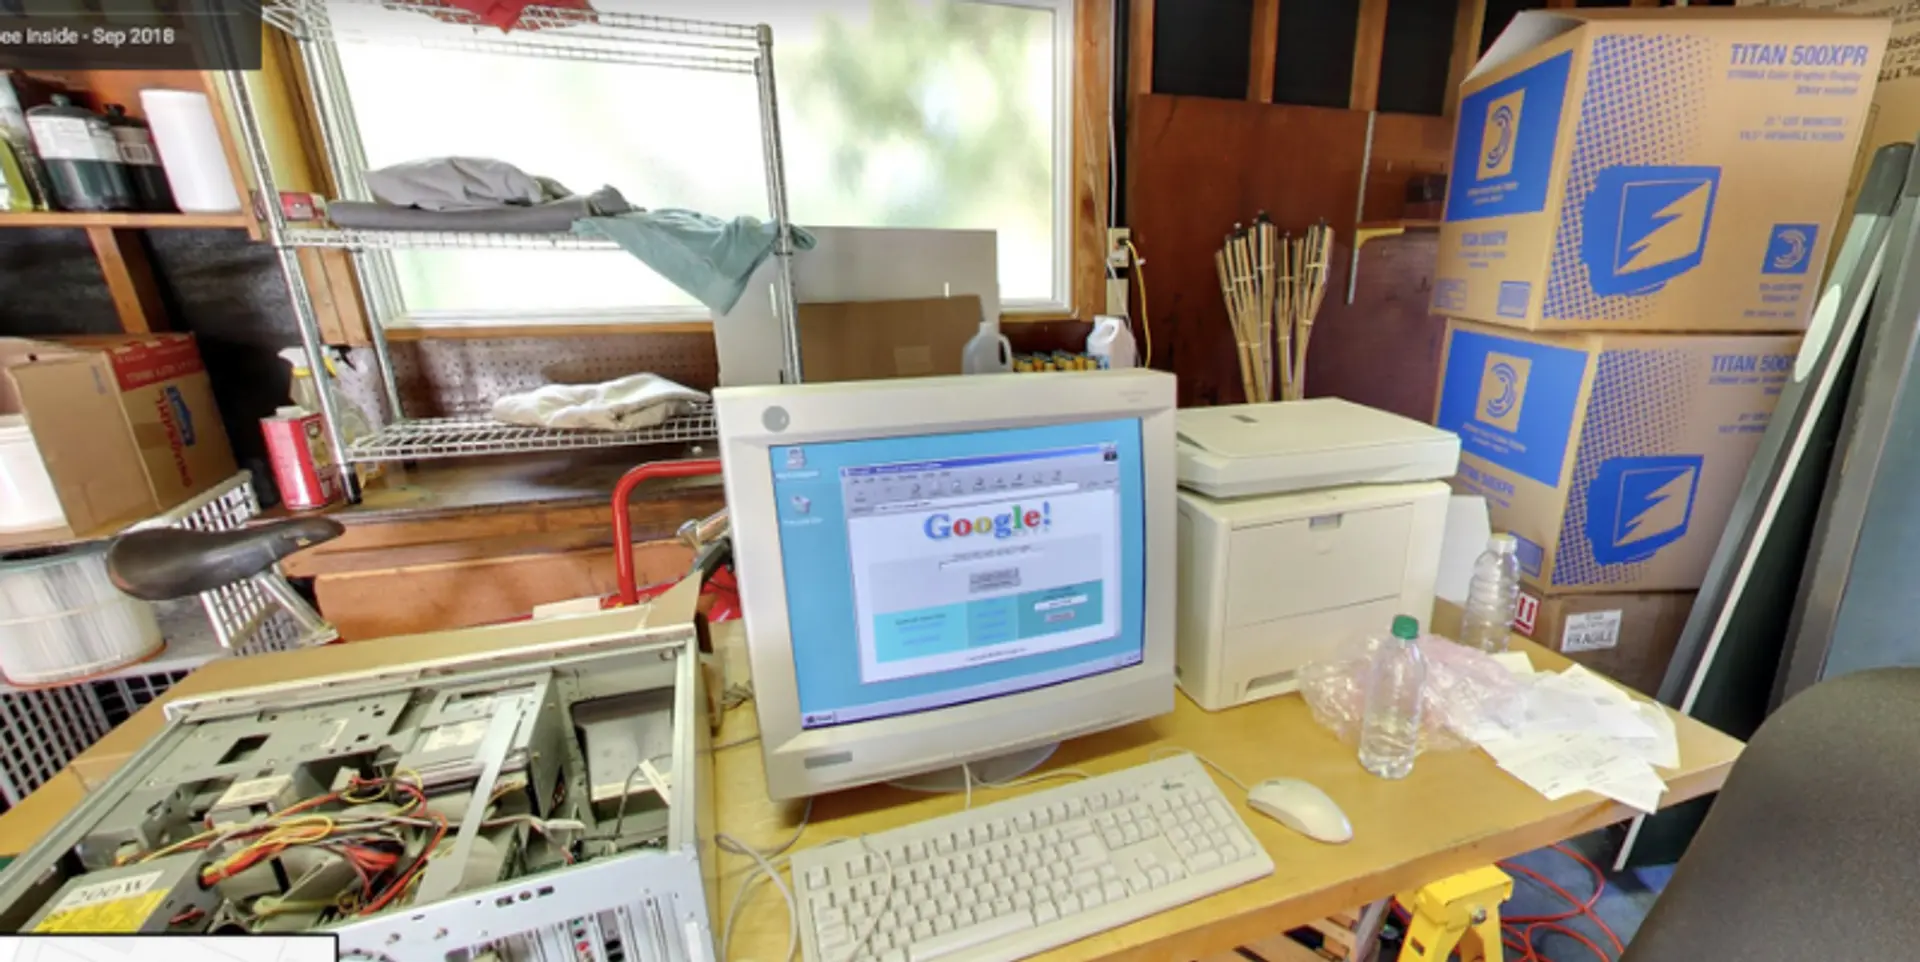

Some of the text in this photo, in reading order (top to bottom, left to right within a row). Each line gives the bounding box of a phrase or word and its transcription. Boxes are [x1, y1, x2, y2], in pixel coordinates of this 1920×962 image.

[1729, 43, 1788, 65] TITAN
[1791, 44, 1869, 67] 500XPR
[1711, 355, 1757, 372] TITAN
[923, 500, 1051, 540] Google!
